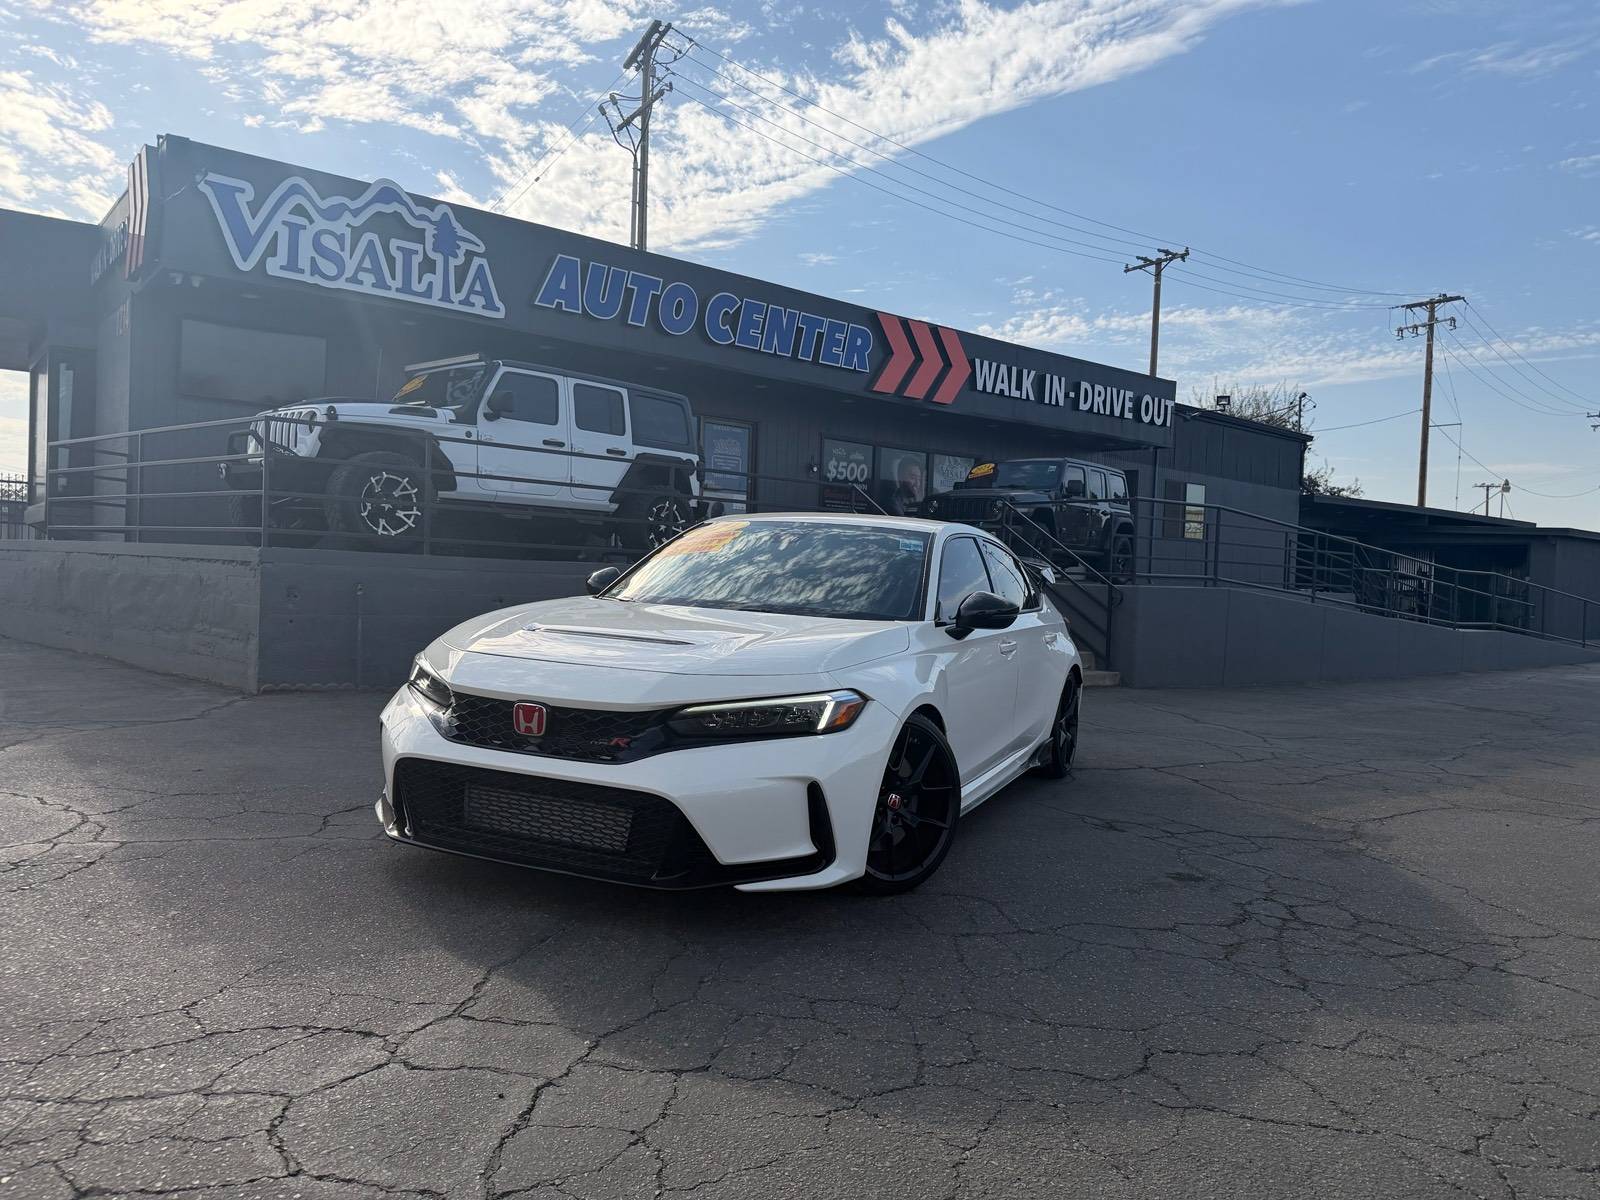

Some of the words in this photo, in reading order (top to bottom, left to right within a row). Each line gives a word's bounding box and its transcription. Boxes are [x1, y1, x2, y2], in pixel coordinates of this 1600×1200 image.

[198, 173, 506, 319] VISALIA
[534, 253, 698, 335] AUTO
[705, 292, 872, 373] CENTER
[974, 358, 1036, 401] WALK
[1140, 394, 1175, 427] OUT
[826, 456, 868, 482] $500
